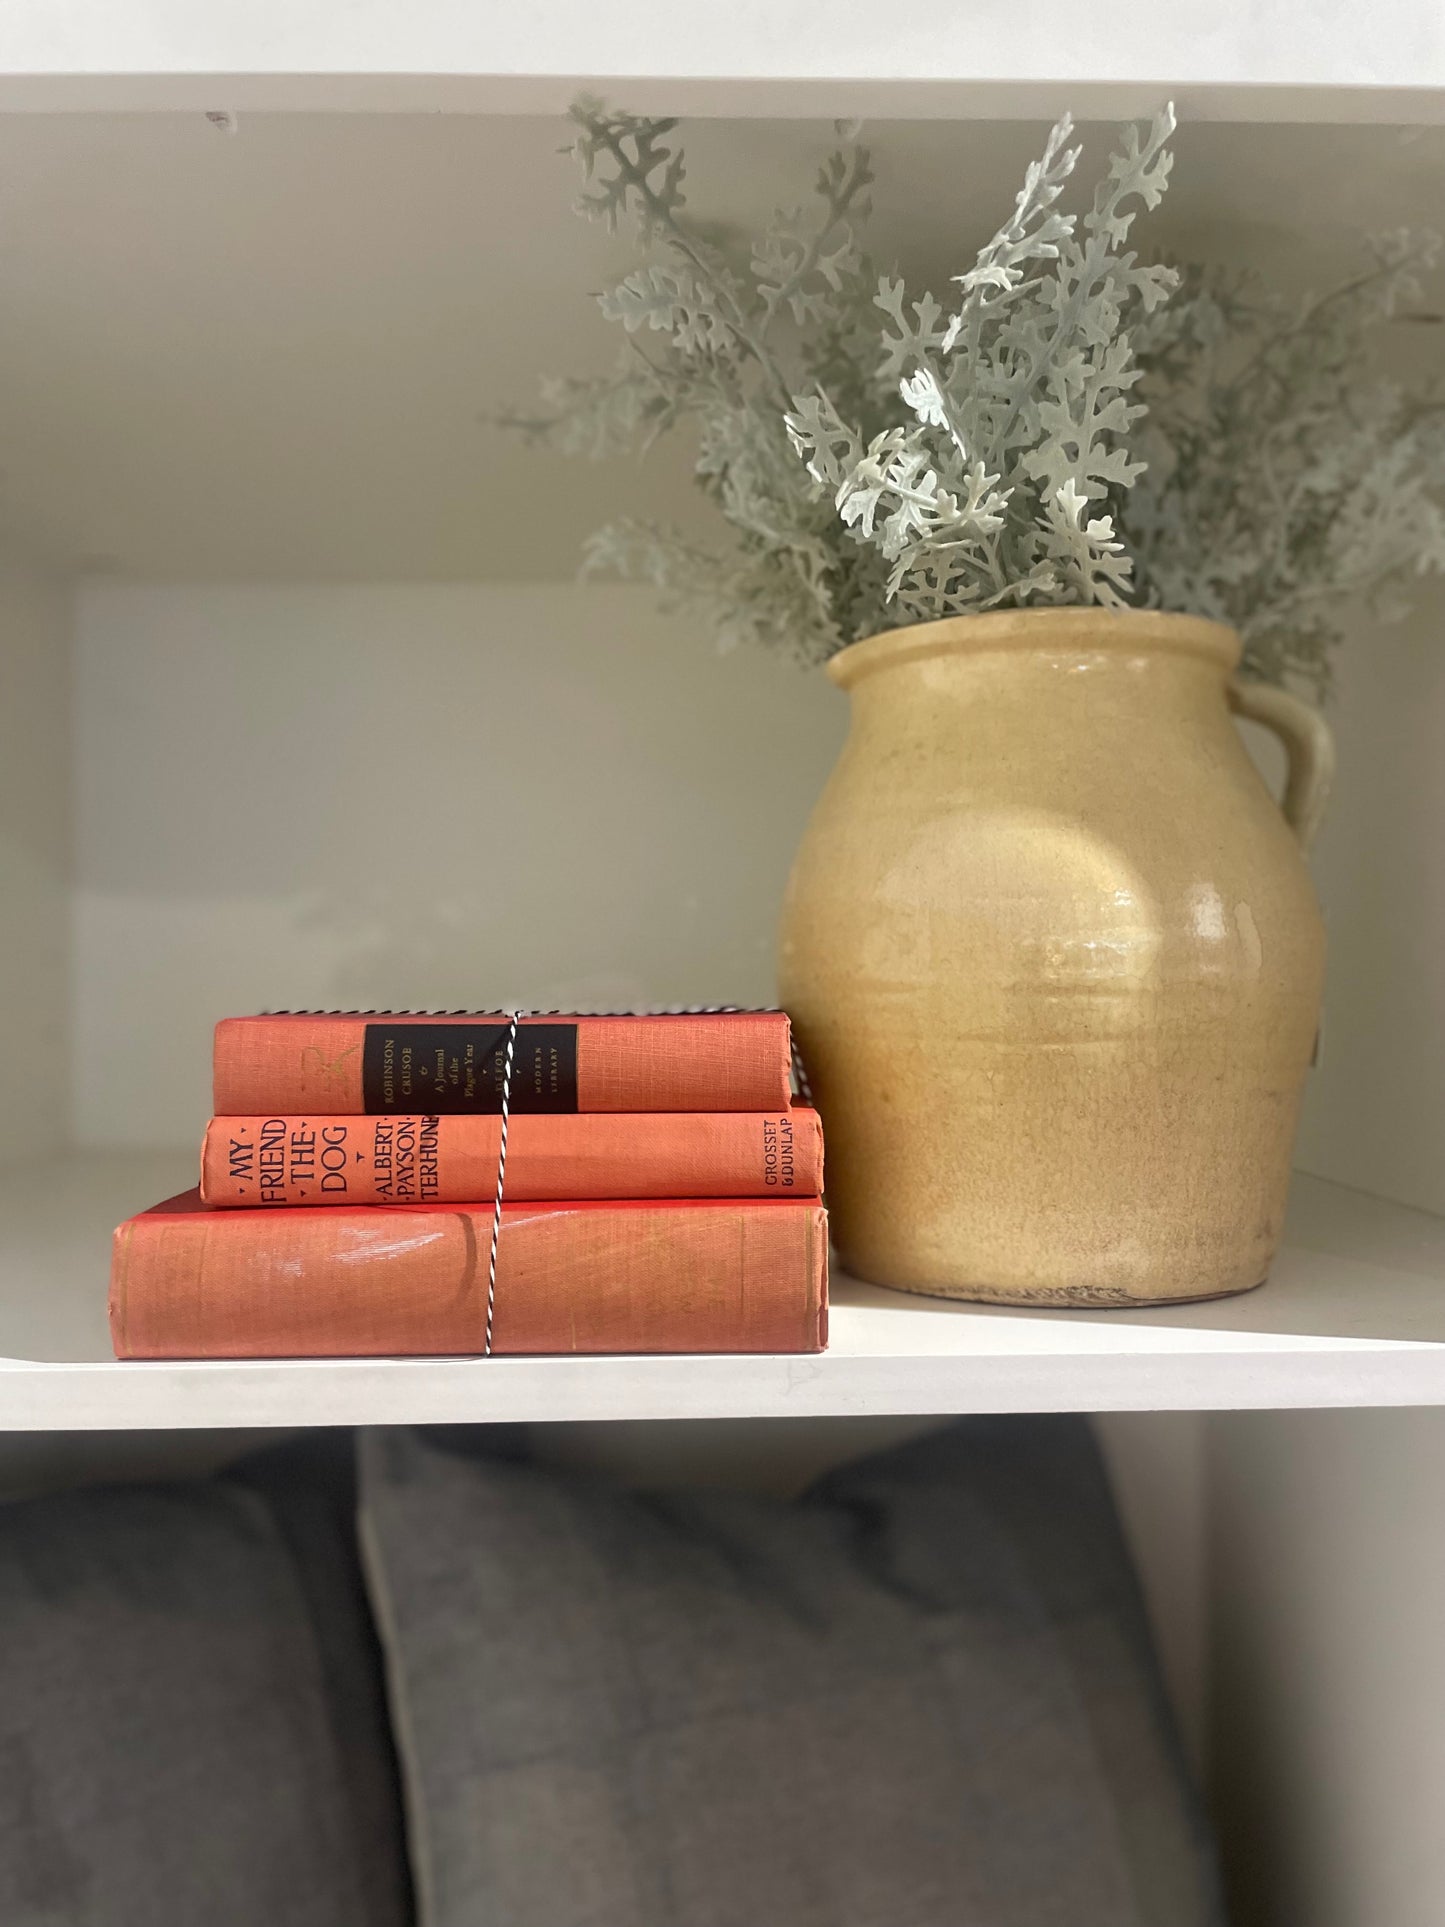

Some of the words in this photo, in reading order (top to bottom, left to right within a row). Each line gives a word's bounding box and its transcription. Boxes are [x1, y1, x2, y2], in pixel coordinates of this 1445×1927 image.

[383, 1039, 395, 1104] ROBINSON
[402, 1047, 413, 1095] CRUSOE
[434, 1049, 447, 1083] Journal
[449, 1057, 459, 1073] the
[463, 1044, 474, 1065] Year
[534, 1047, 542, 1094] MODERN
[550, 1047, 558, 1093] LIBRARY
[434, 1085, 445, 1094] A
[464, 1067, 476, 1097] Plague
[229, 1138, 254, 1181] MY
[259, 1119, 287, 1203] FRIEND
[291, 1131, 316, 1185] THE
[320, 1126, 348, 1193] DOG
[374, 1121, 393, 1196] ALBERT
[396, 1121, 416, 1196] PAYSON
[419, 1115, 440, 1200] TERHUNE
[763, 1119, 778, 1186] GROSSET
